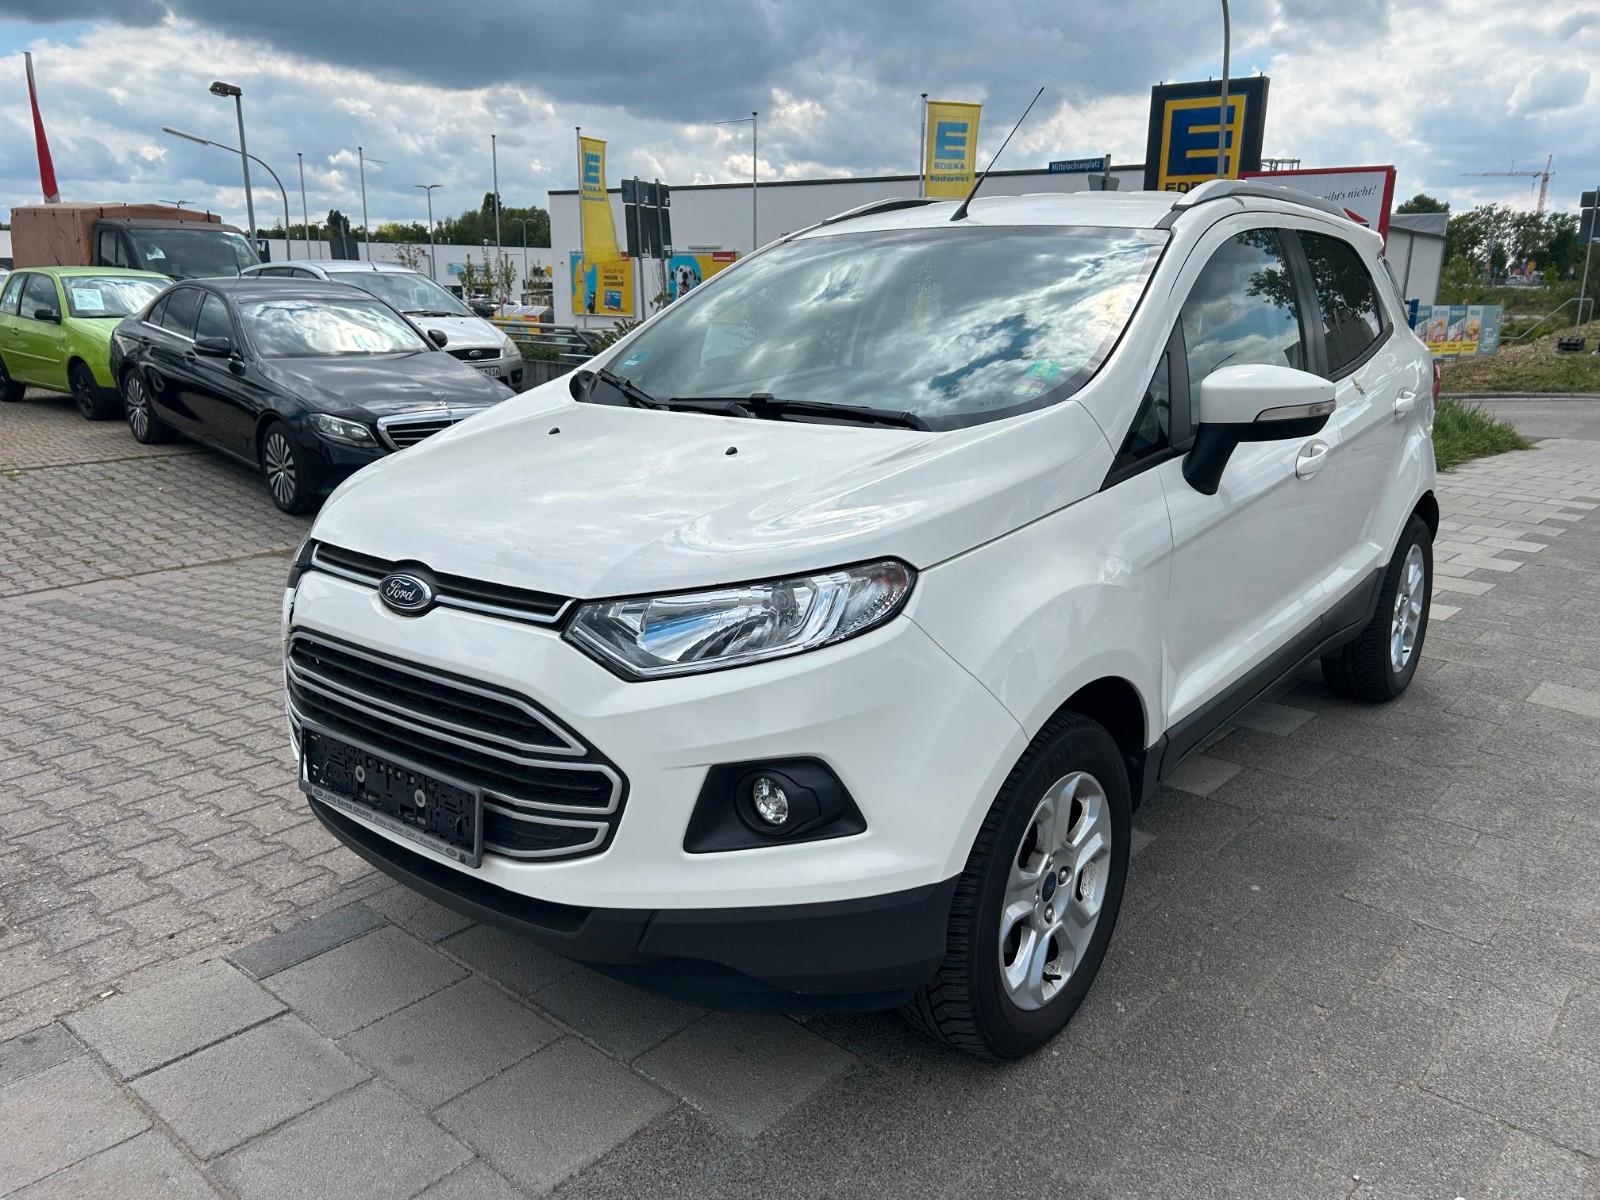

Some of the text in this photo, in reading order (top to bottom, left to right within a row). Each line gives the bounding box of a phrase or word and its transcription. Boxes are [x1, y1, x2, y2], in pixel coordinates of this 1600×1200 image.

[934, 162, 966, 170] EDEKA
[1347, 184, 1377, 199] nicht!
[386, 578, 418, 601] Ford
